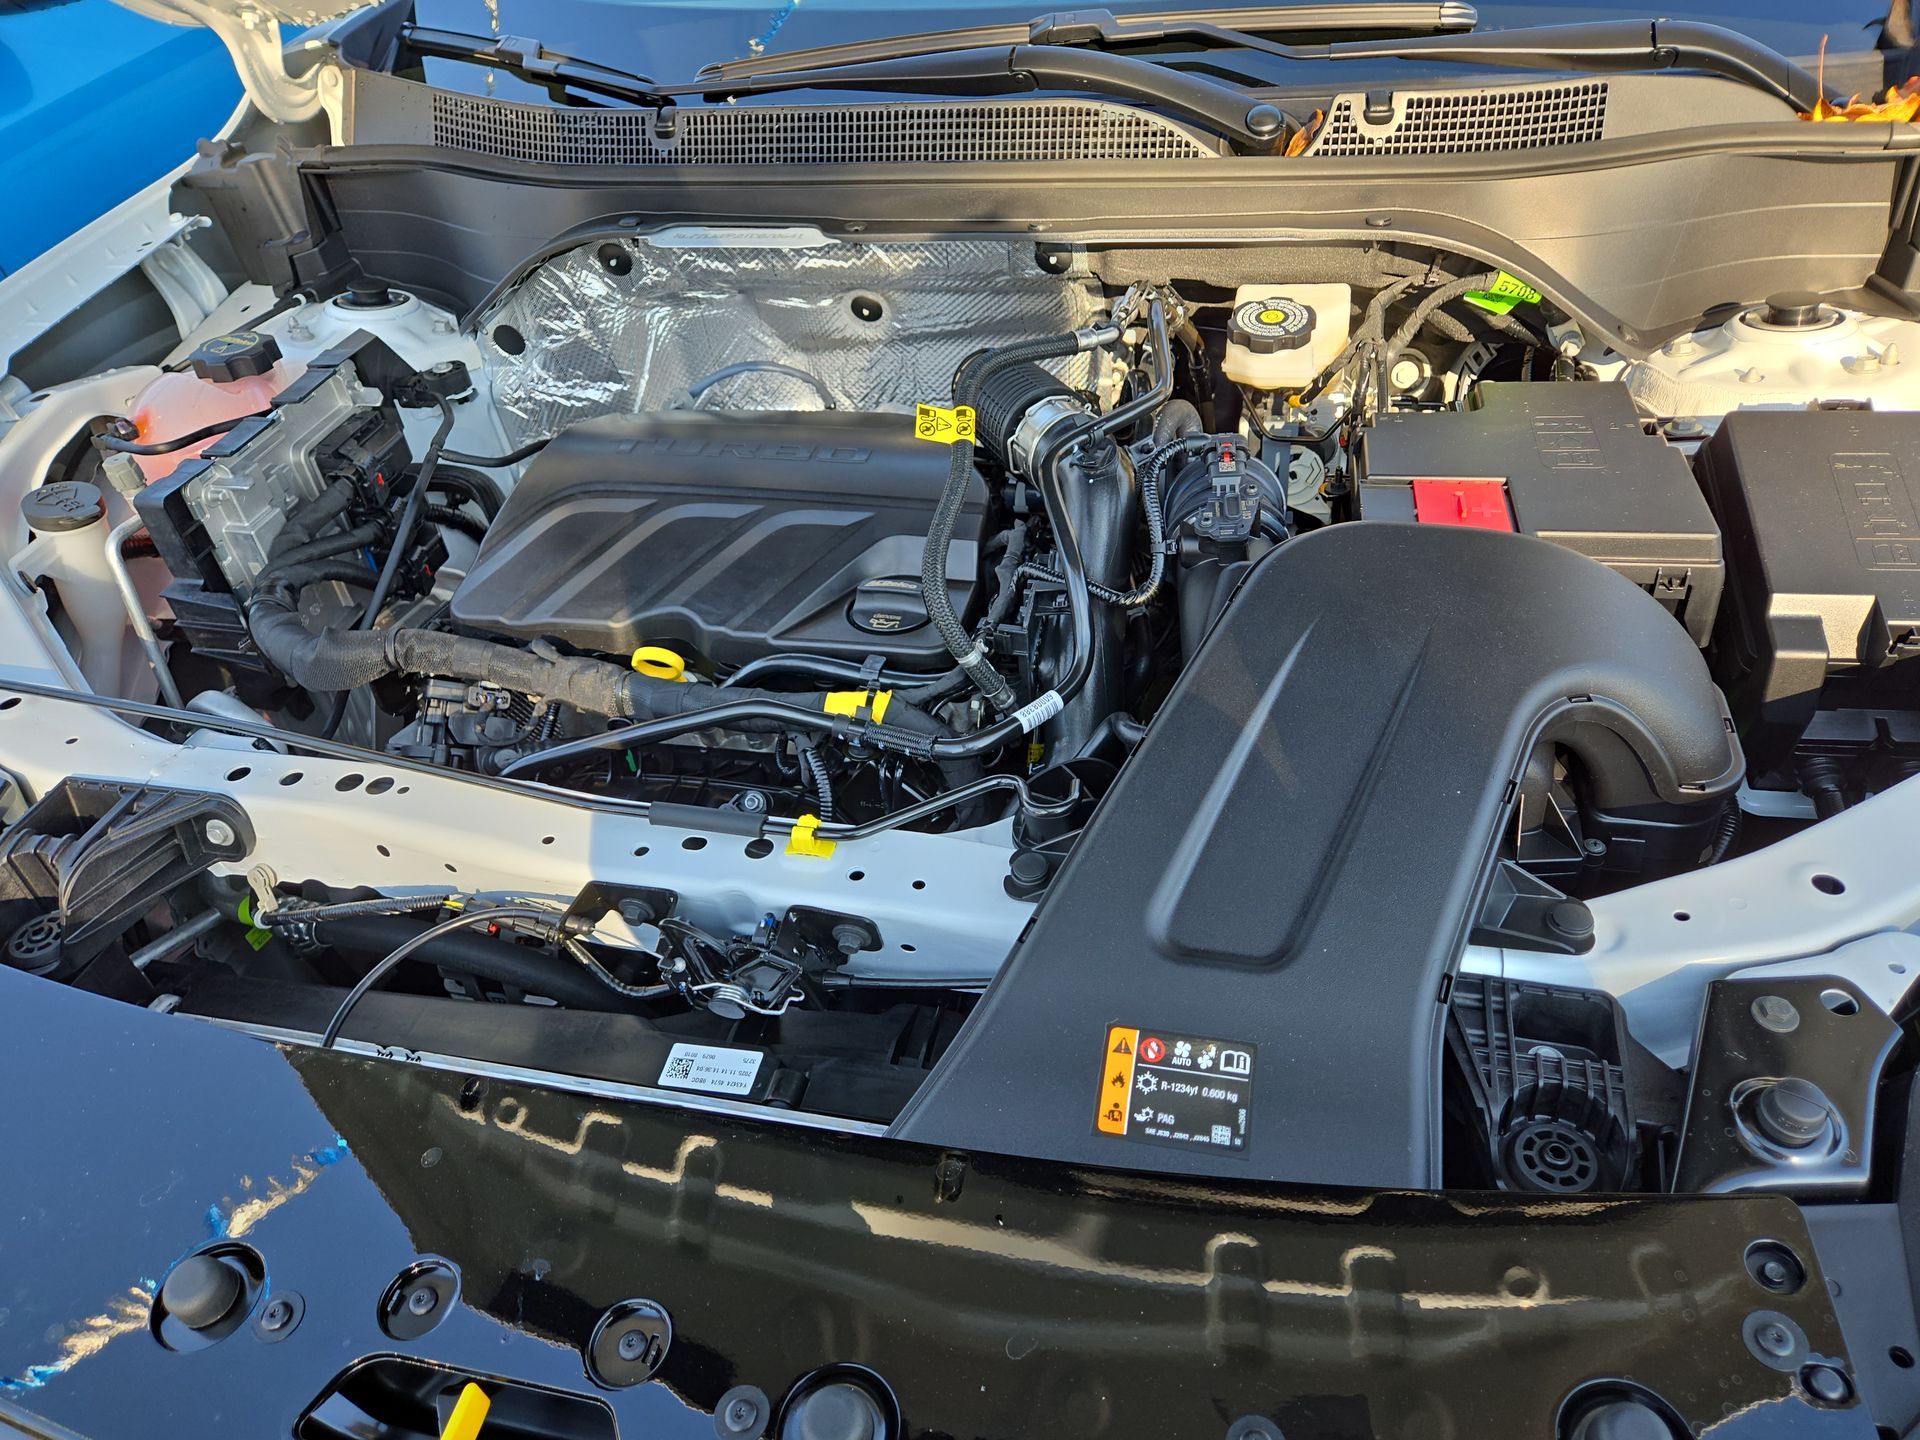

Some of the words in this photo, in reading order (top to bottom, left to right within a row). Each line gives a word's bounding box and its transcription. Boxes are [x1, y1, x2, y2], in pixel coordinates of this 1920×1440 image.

[610, 438, 873, 464] TURBO
[1172, 1056, 1192, 1067] AUTO
[1161, 1081, 1198, 1096] R-1234yf
[1227, 1090, 1238, 1103] kg
[1157, 1112, 1175, 1125] PAG
